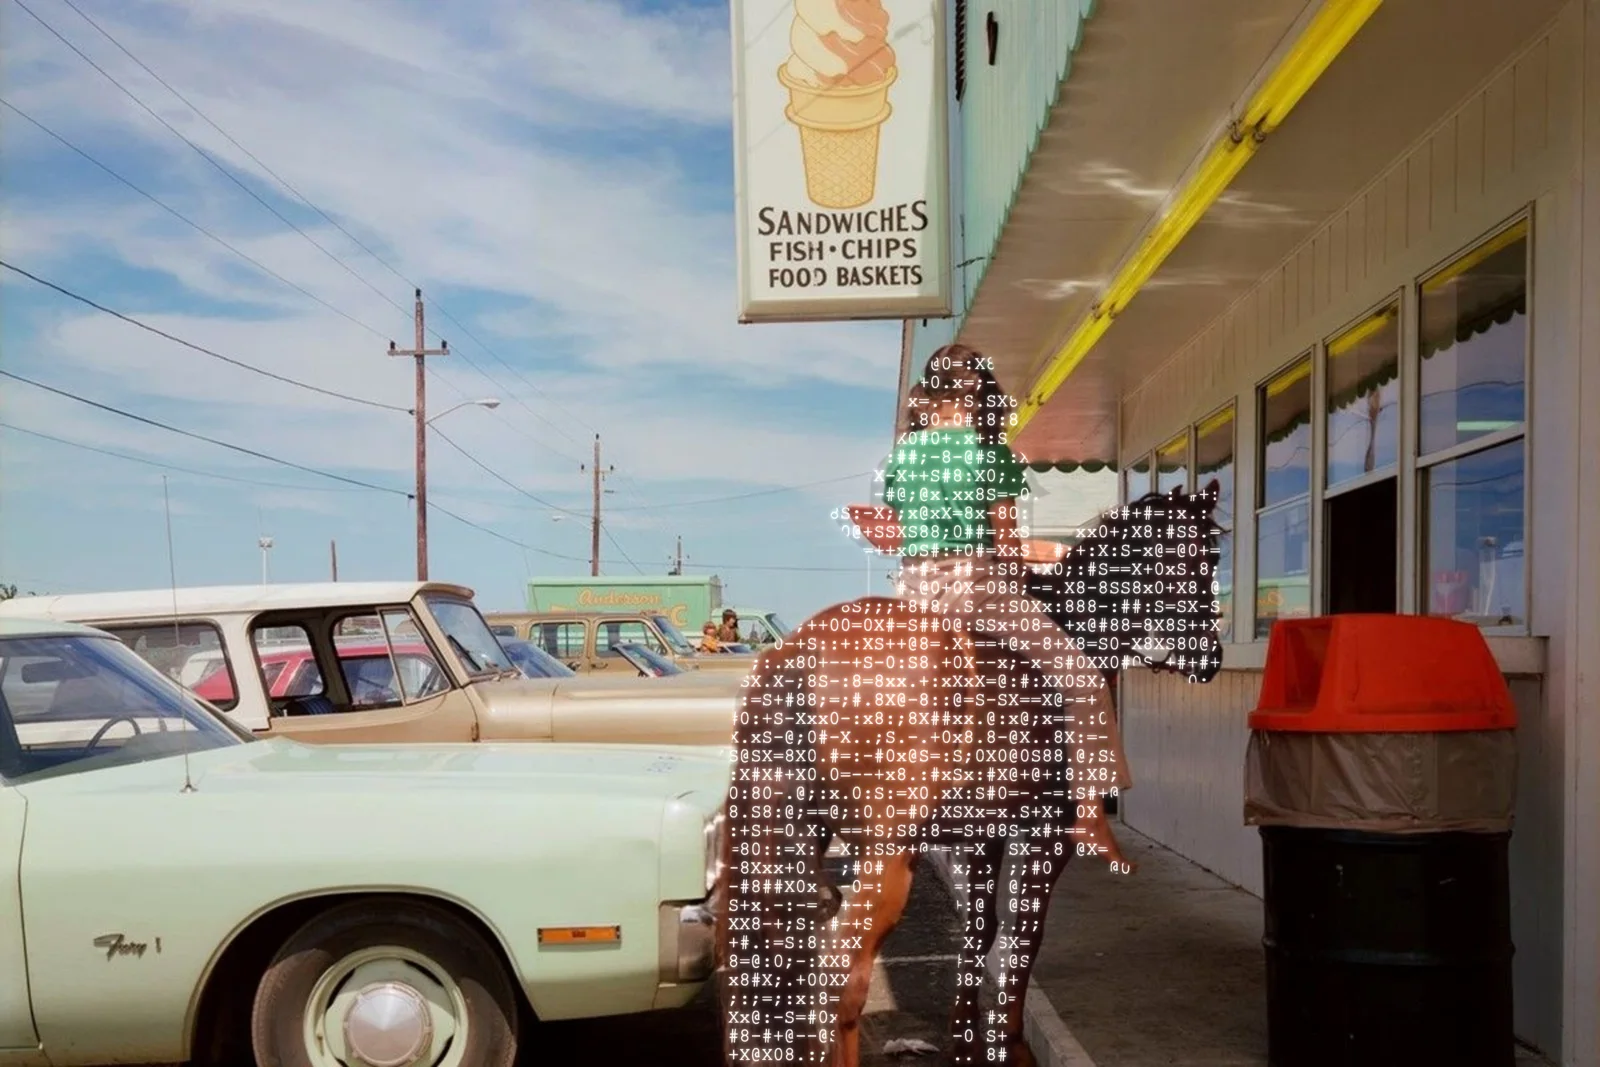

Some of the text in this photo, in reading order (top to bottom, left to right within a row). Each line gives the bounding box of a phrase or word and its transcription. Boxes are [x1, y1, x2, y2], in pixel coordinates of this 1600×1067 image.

[758, 200, 928, 236] SANDWICHES
[841, 238, 917, 260] CHIPS
[768, 265, 923, 288] FOOD BASKETS
[93, 933, 147, 962] Fury
